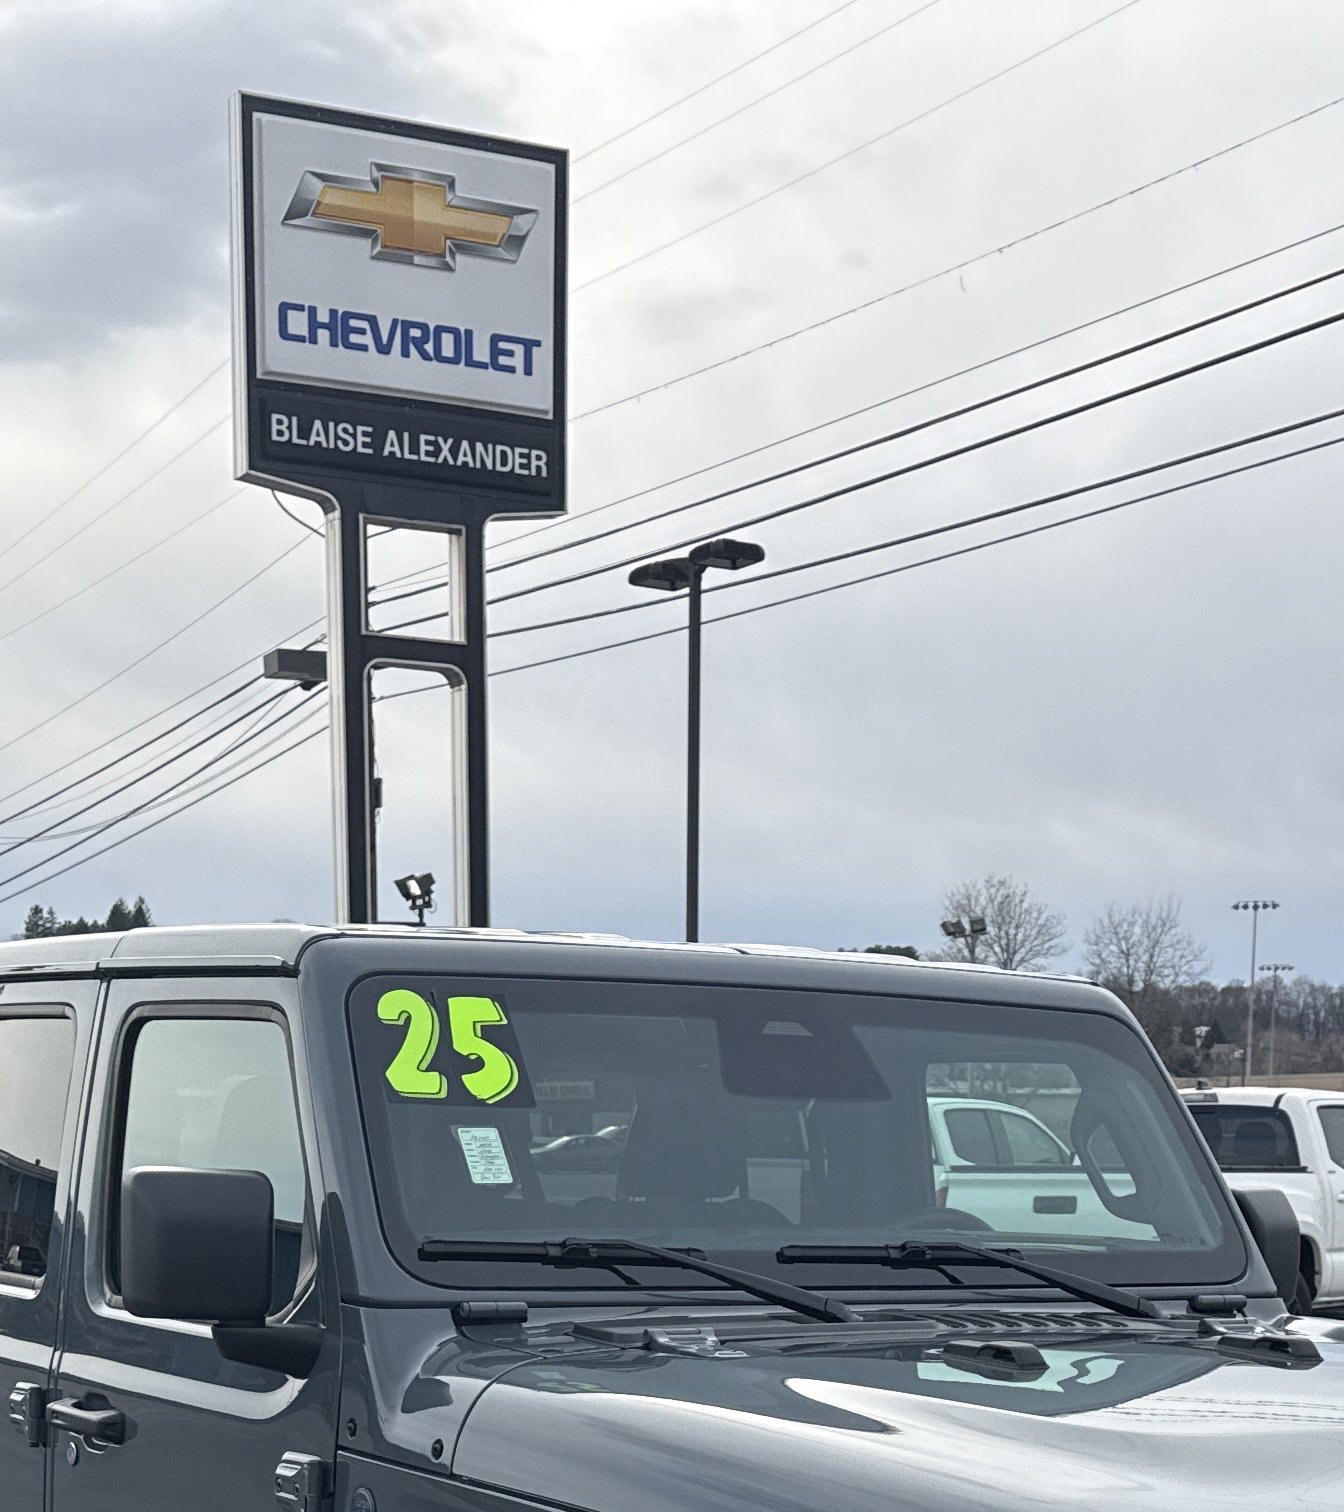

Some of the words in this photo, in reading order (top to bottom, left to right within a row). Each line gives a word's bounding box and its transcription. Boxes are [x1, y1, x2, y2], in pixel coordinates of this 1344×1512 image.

[277, 301, 542, 376] CHEVROLET
[270, 413, 374, 455] BLAISE
[382, 430, 548, 478] ALEXANDER
[377, 989, 519, 1105] 25
